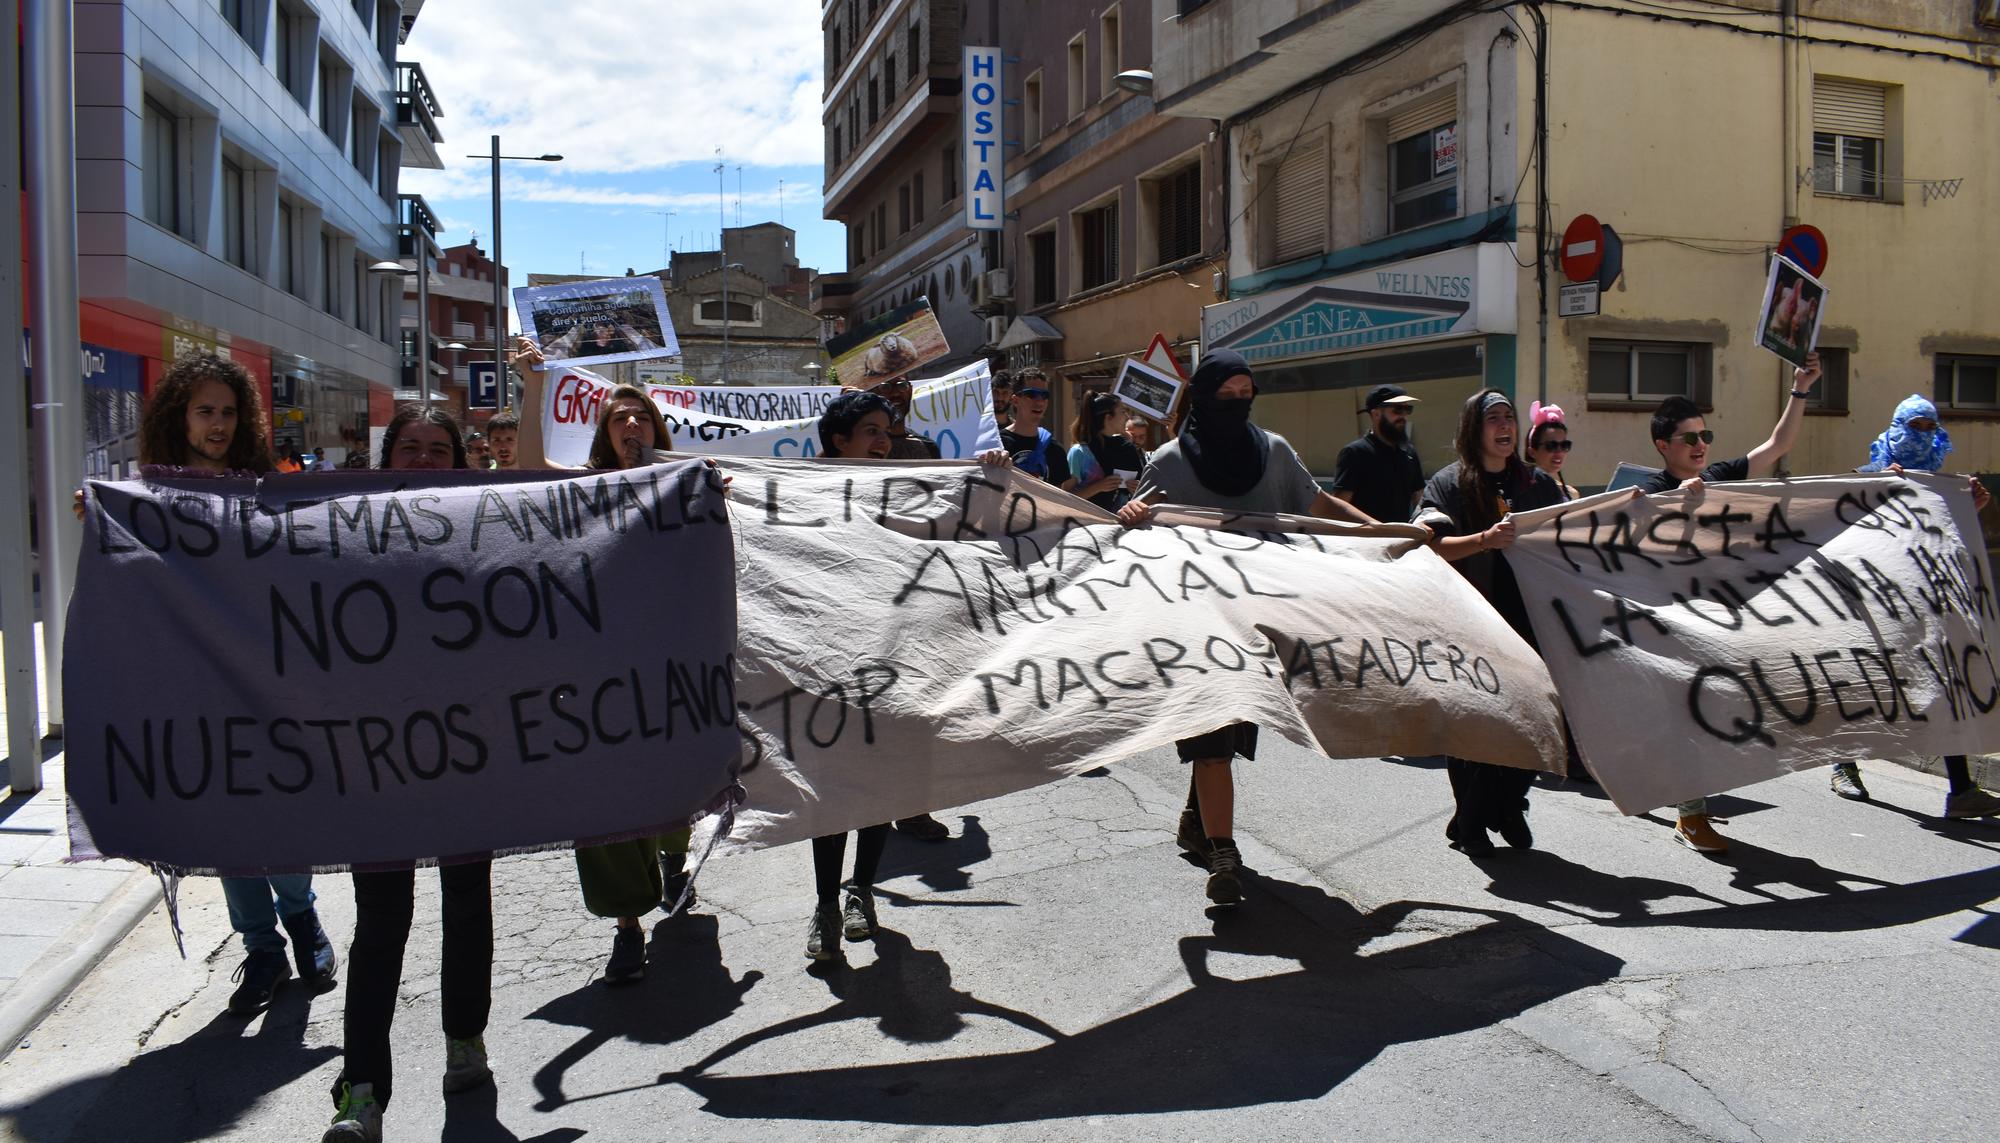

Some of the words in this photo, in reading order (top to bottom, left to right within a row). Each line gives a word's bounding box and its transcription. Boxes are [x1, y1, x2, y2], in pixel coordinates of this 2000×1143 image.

[972, 55, 995, 220] HOSTAL
[1207, 301, 1259, 342] CENTRO
[1268, 308, 1373, 343] ATENEA
[1376, 272, 1470, 298] WELLNESS
[701, 391, 833, 422] MACROGRANJAS
[97, 490, 220, 558] LOS
[470, 466, 730, 552] ANIMALES
[1554, 502, 1822, 573] HASTA
[1834, 484, 1943, 538] QUE
[270, 578, 397, 677] NO
[421, 552, 602, 651] SON
[1551, 595, 1669, 657] LA
[737, 664, 899, 776] STOP
[1688, 647, 1928, 748] QUEDE
[105, 703, 489, 804] NUESTROS
